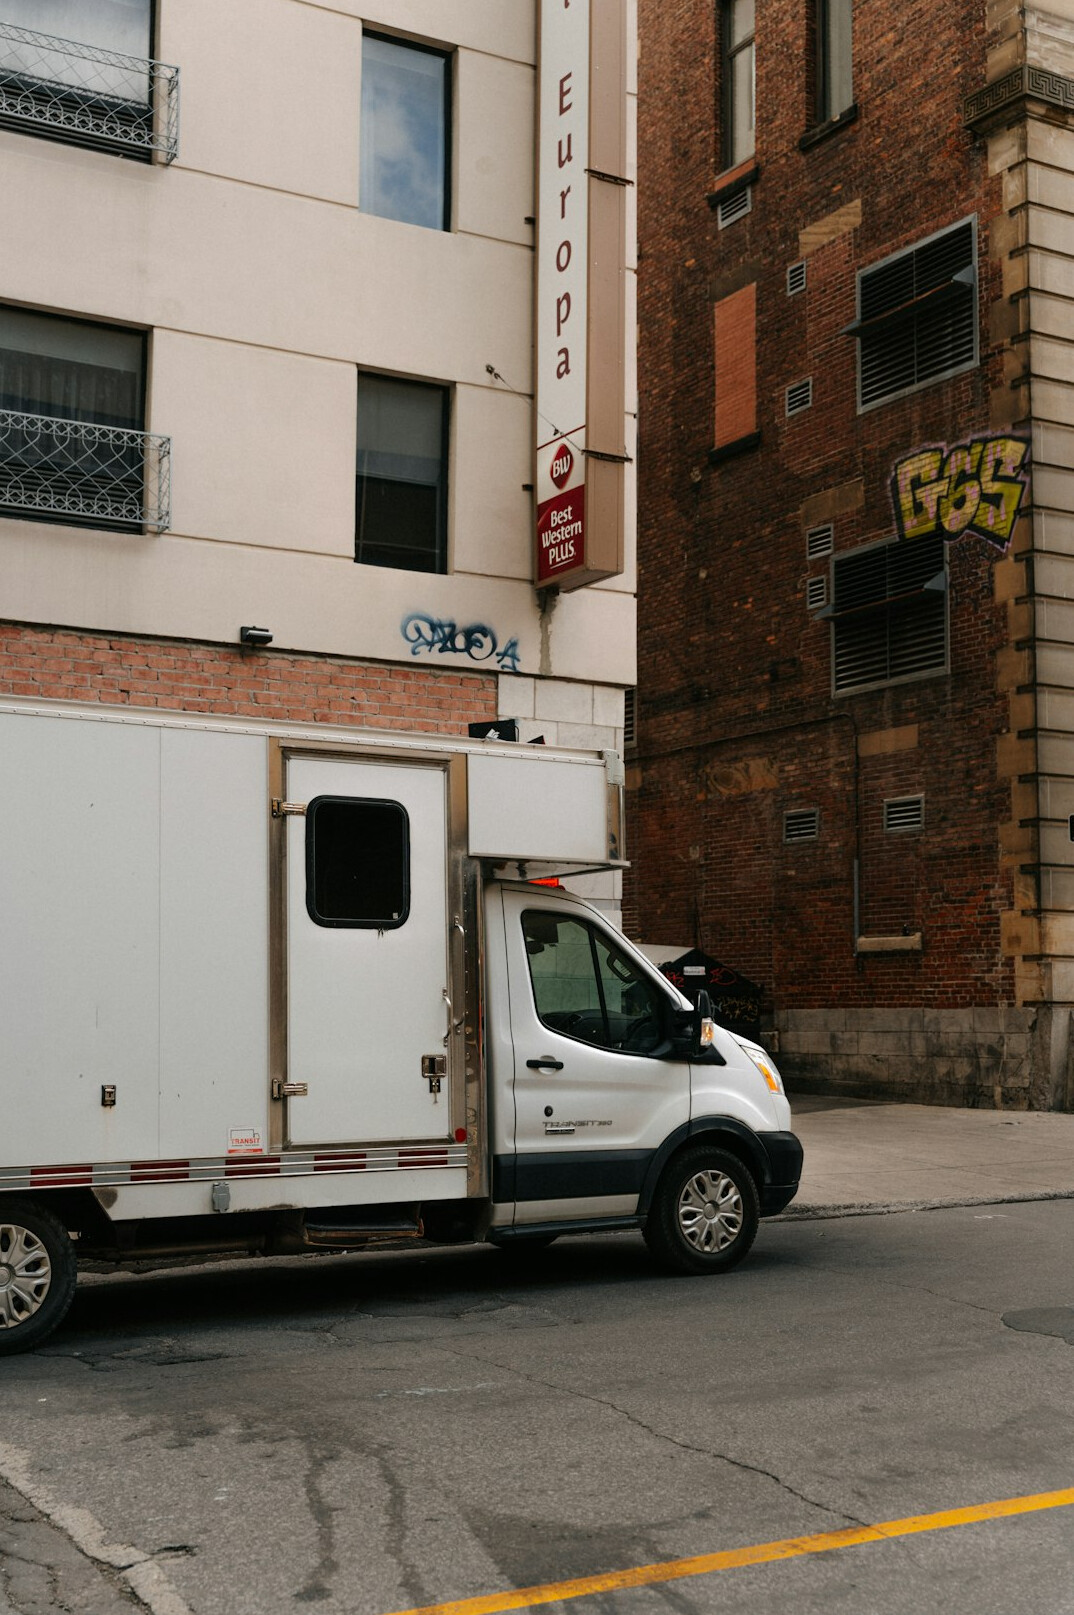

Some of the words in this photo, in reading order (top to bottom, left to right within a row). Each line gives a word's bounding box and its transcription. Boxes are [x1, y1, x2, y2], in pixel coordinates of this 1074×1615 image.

[556, 72, 573, 379] Europa
[552, 454, 571, 478] BW
[550, 505, 573, 528] Best
[541, 520, 583, 549] Western
[549, 540, 575, 565] PLUS
[542, 1120, 598, 1128] TRANSIT
